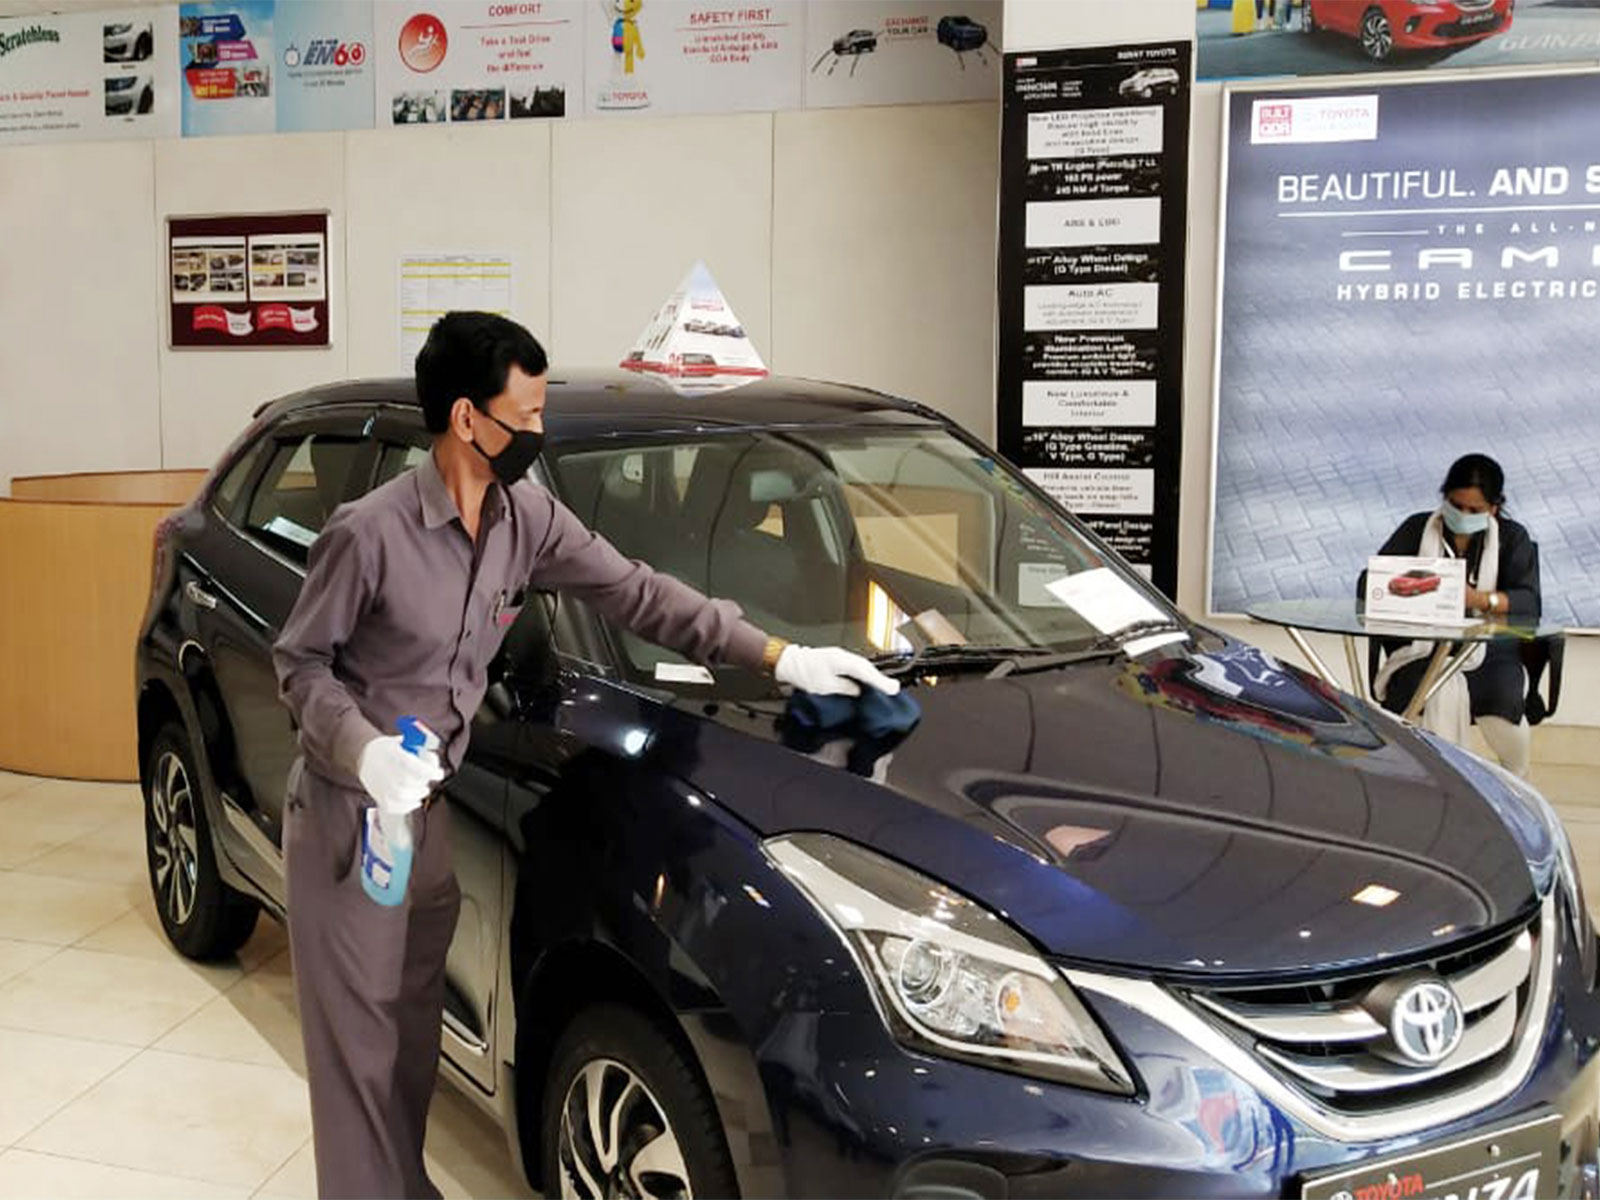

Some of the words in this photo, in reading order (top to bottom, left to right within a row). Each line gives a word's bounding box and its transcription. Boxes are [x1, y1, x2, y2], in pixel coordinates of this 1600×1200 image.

[488, 3, 542, 17] COMFORT
[690, 11, 734, 25] SAFETY
[737, 9, 771, 21] FIRST
[887, 27, 909, 35] YOUR
[911, 26, 928, 34] CAR
[1146, 47, 1177, 58] TOYOTA
[611, 91, 649, 102] TOYOTA
[1319, 107, 1370, 120] TOYOTA
[1095, 173, 1123, 183] power
[1100, 183, 1130, 194] Torque
[1277, 169, 1477, 203] BEAUTIFUL.
[1488, 166, 1570, 197] AND
[1437, 223, 1485, 235] THE
[1053, 255, 1078, 266] Alloy
[1080, 253, 1112, 263] Wheel
[1339, 244, 1600, 271] CAM
[1068, 264, 1092, 275] Type
[1093, 263, 1129, 273] Diesel)
[1068, 290, 1094, 298] Auto
[1096, 289, 1113, 297] AC
[1336, 283, 1441, 301] HYBRID
[1457, 280, 1600, 299] ELECTRIC
[1079, 334, 1125, 343] Premium
[1050, 433, 1075, 443] Alloy
[1077, 433, 1108, 441] Wheel
[1059, 443, 1083, 452] Type
[1098, 452, 1126, 462] Type)
[1352, 1173, 1425, 1200] TOYOTA
